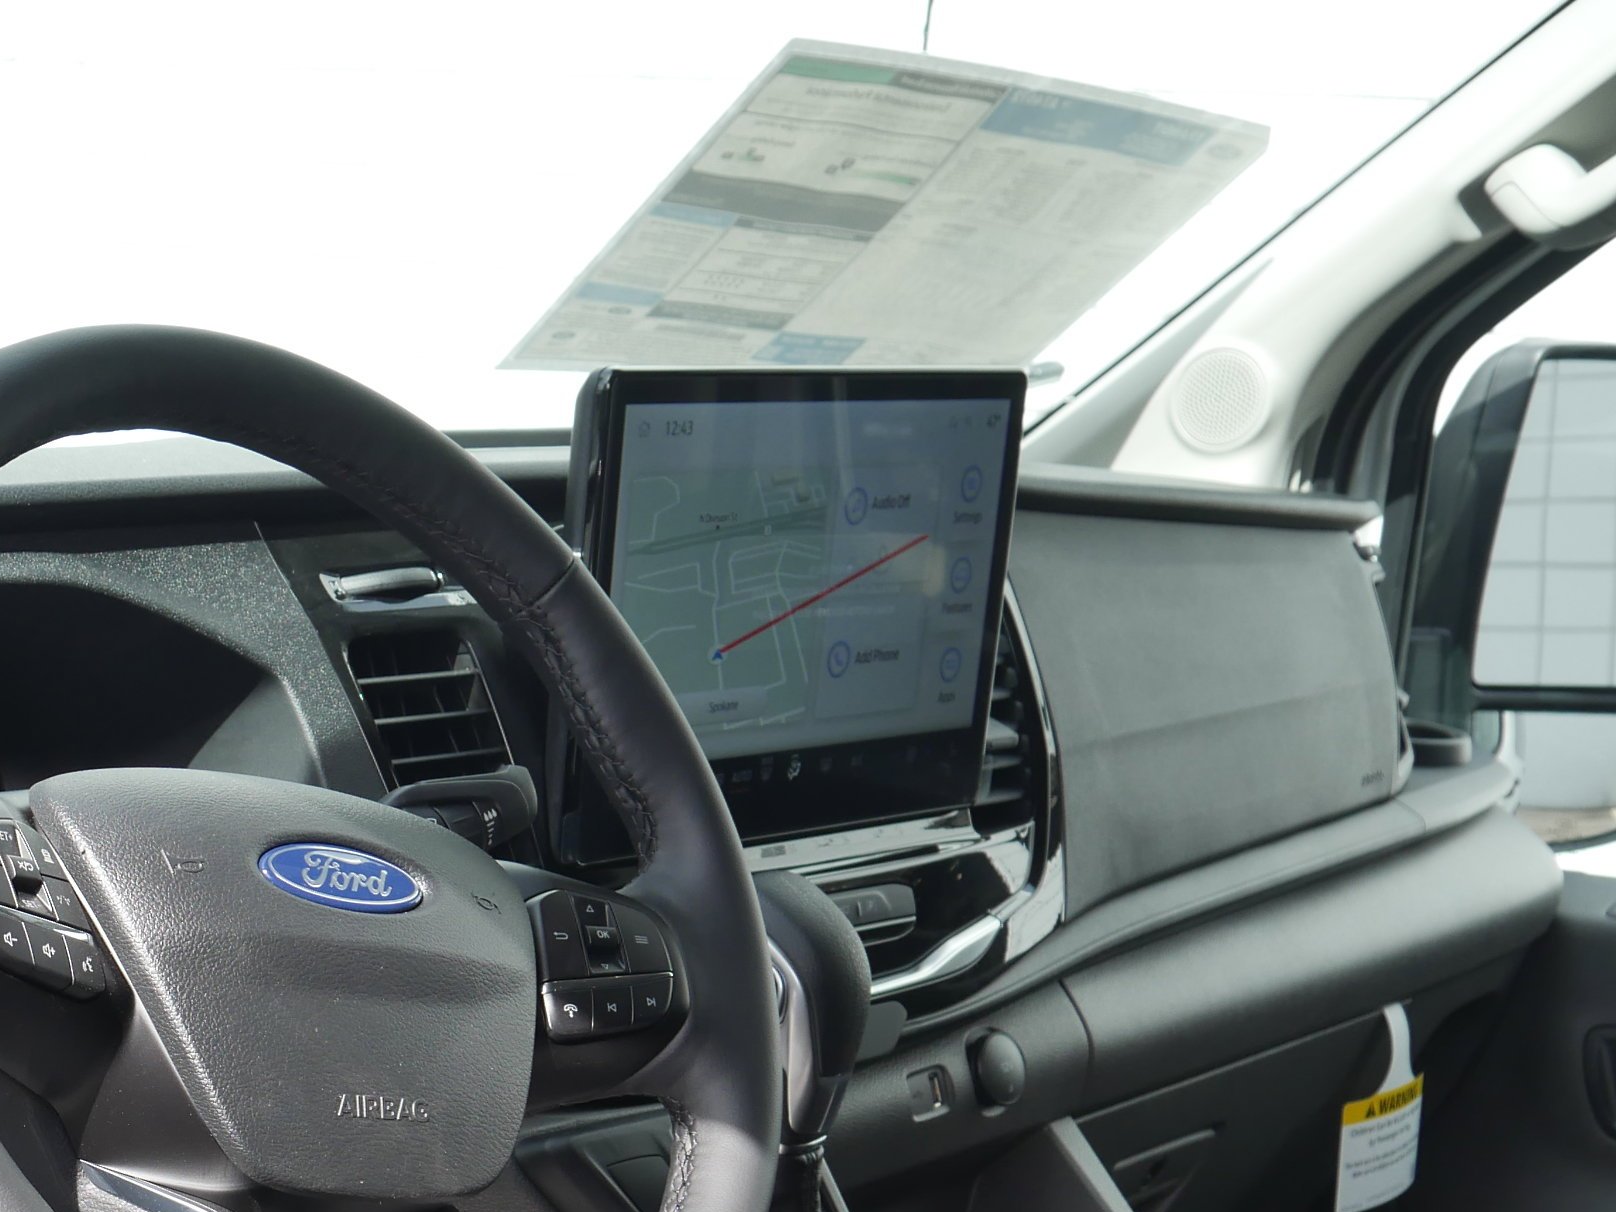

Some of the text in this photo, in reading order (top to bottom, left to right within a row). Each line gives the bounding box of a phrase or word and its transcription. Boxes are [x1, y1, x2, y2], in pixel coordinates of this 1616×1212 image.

[665, 420, 694, 436] 12:43
[301, 848, 394, 900] Ford
[596, 930, 610, 939] OK
[336, 1093, 430, 1124] AIRBAG
